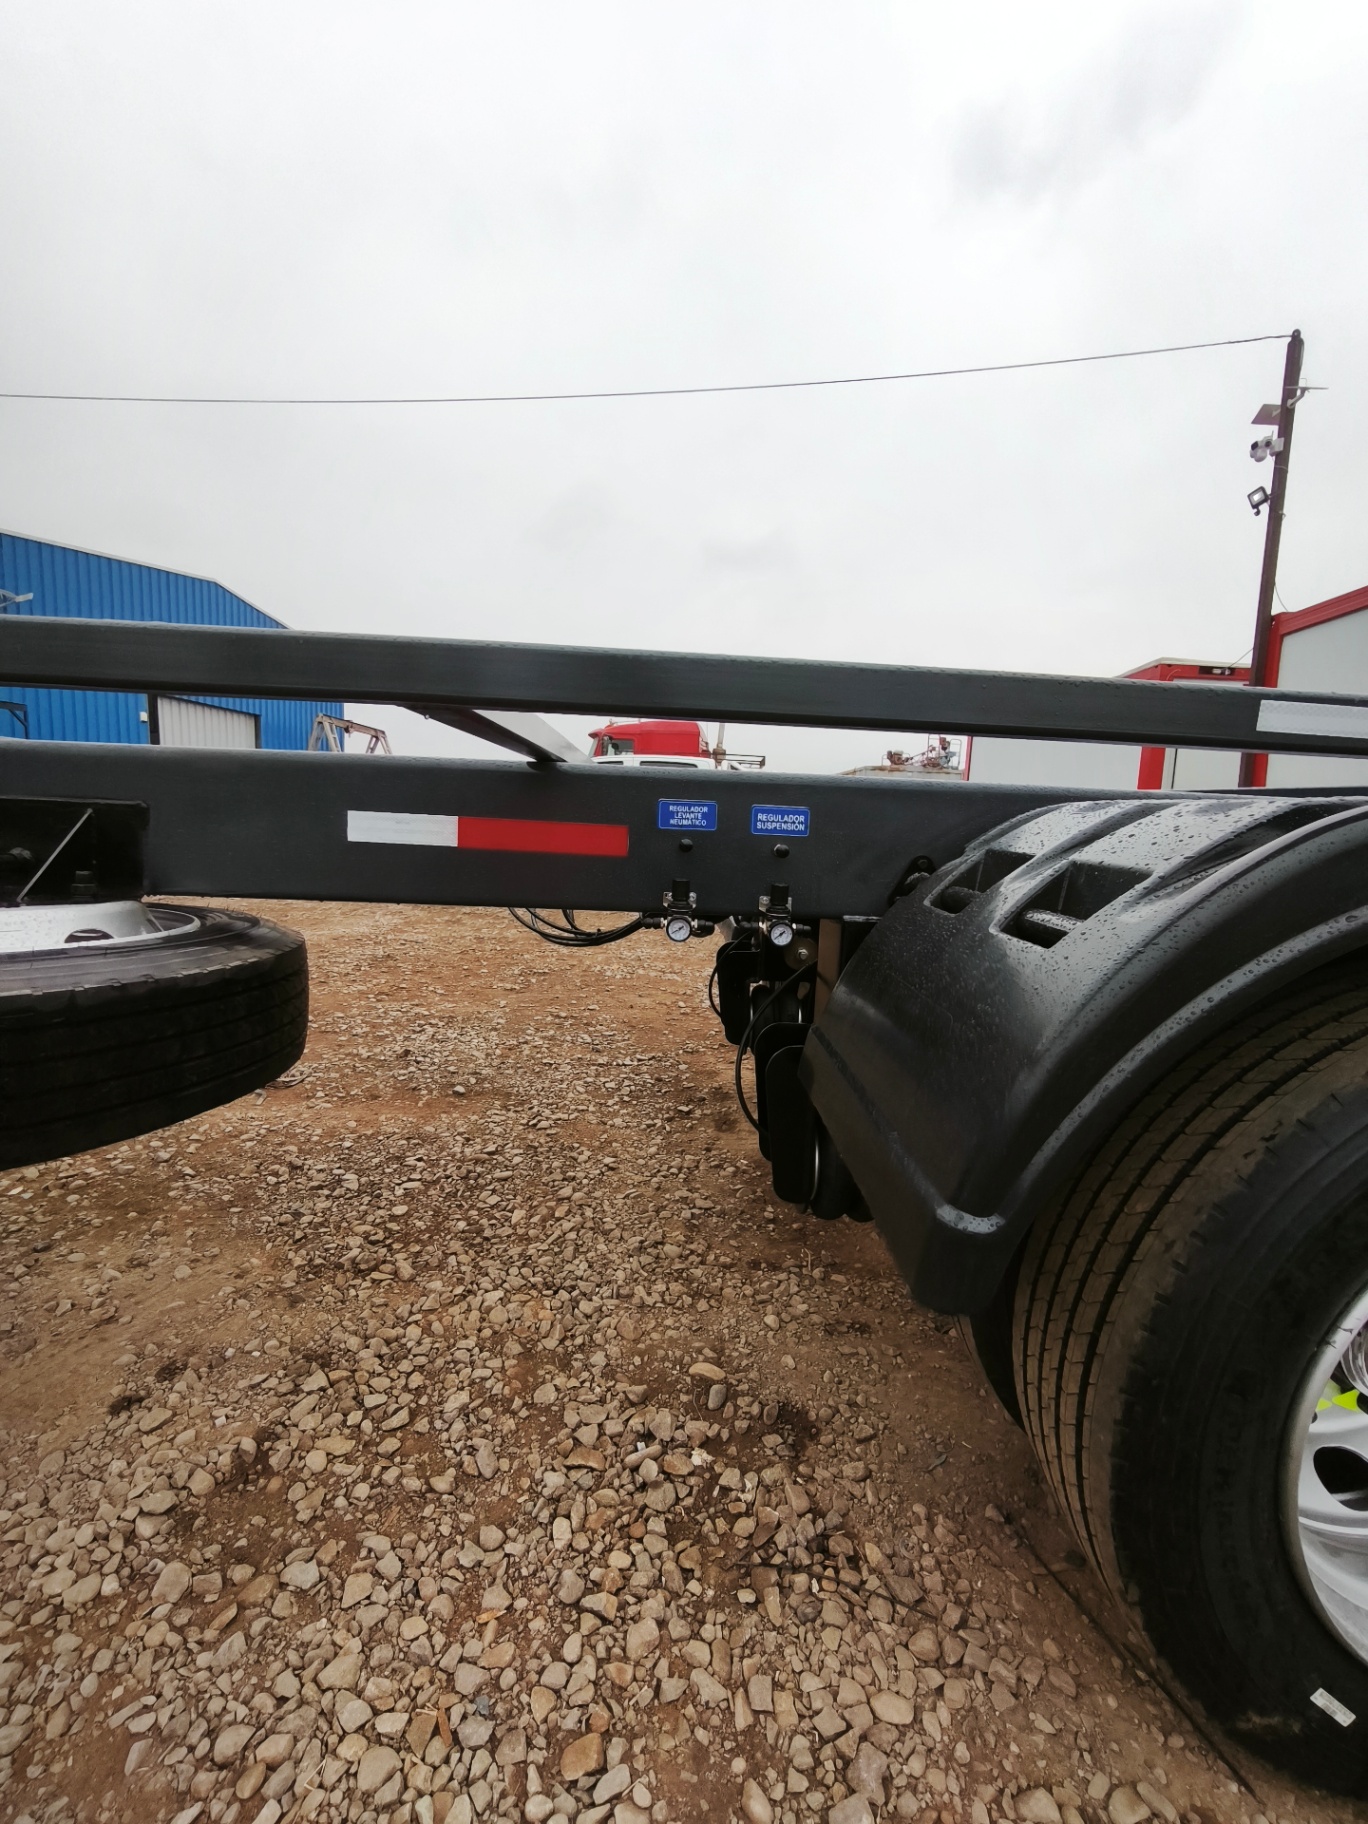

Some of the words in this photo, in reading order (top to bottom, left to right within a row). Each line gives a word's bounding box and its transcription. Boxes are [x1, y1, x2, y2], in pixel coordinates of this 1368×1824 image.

[669, 805, 708, 813] REGULADOR
[757, 813, 805, 822] REGULADOR
[757, 821, 805, 831] SUSPENSIÓN
